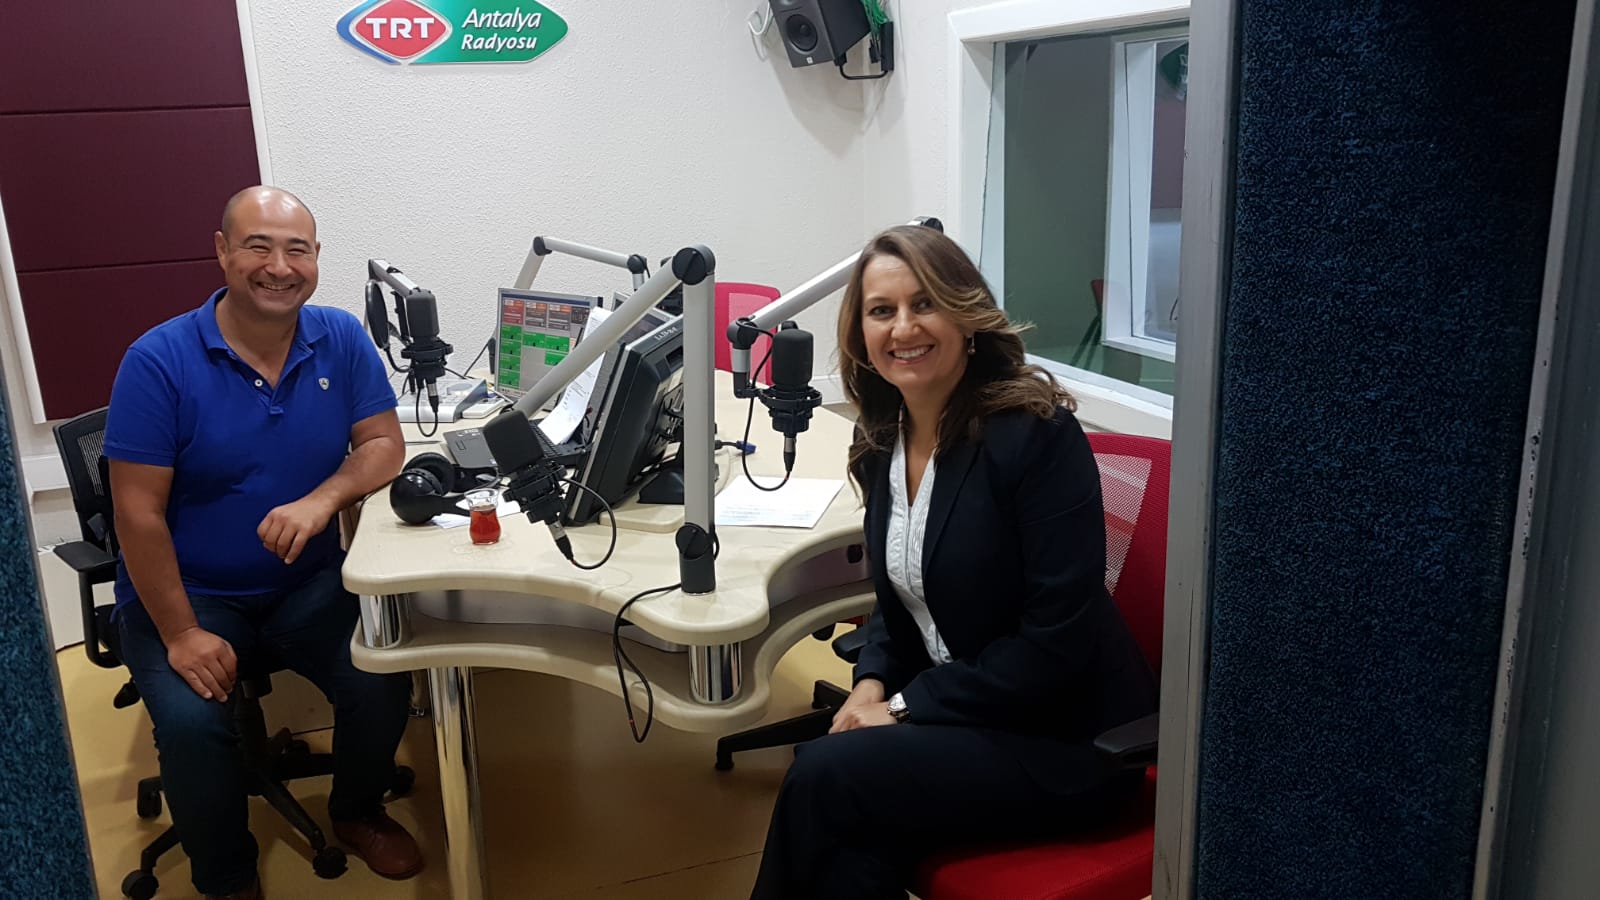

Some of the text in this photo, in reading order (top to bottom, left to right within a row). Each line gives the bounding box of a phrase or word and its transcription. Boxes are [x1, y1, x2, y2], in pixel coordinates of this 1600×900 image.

[366, 18, 434, 38] TRT
[462, 8, 541, 33] Antalya
[461, 34, 537, 52] Radyosu
